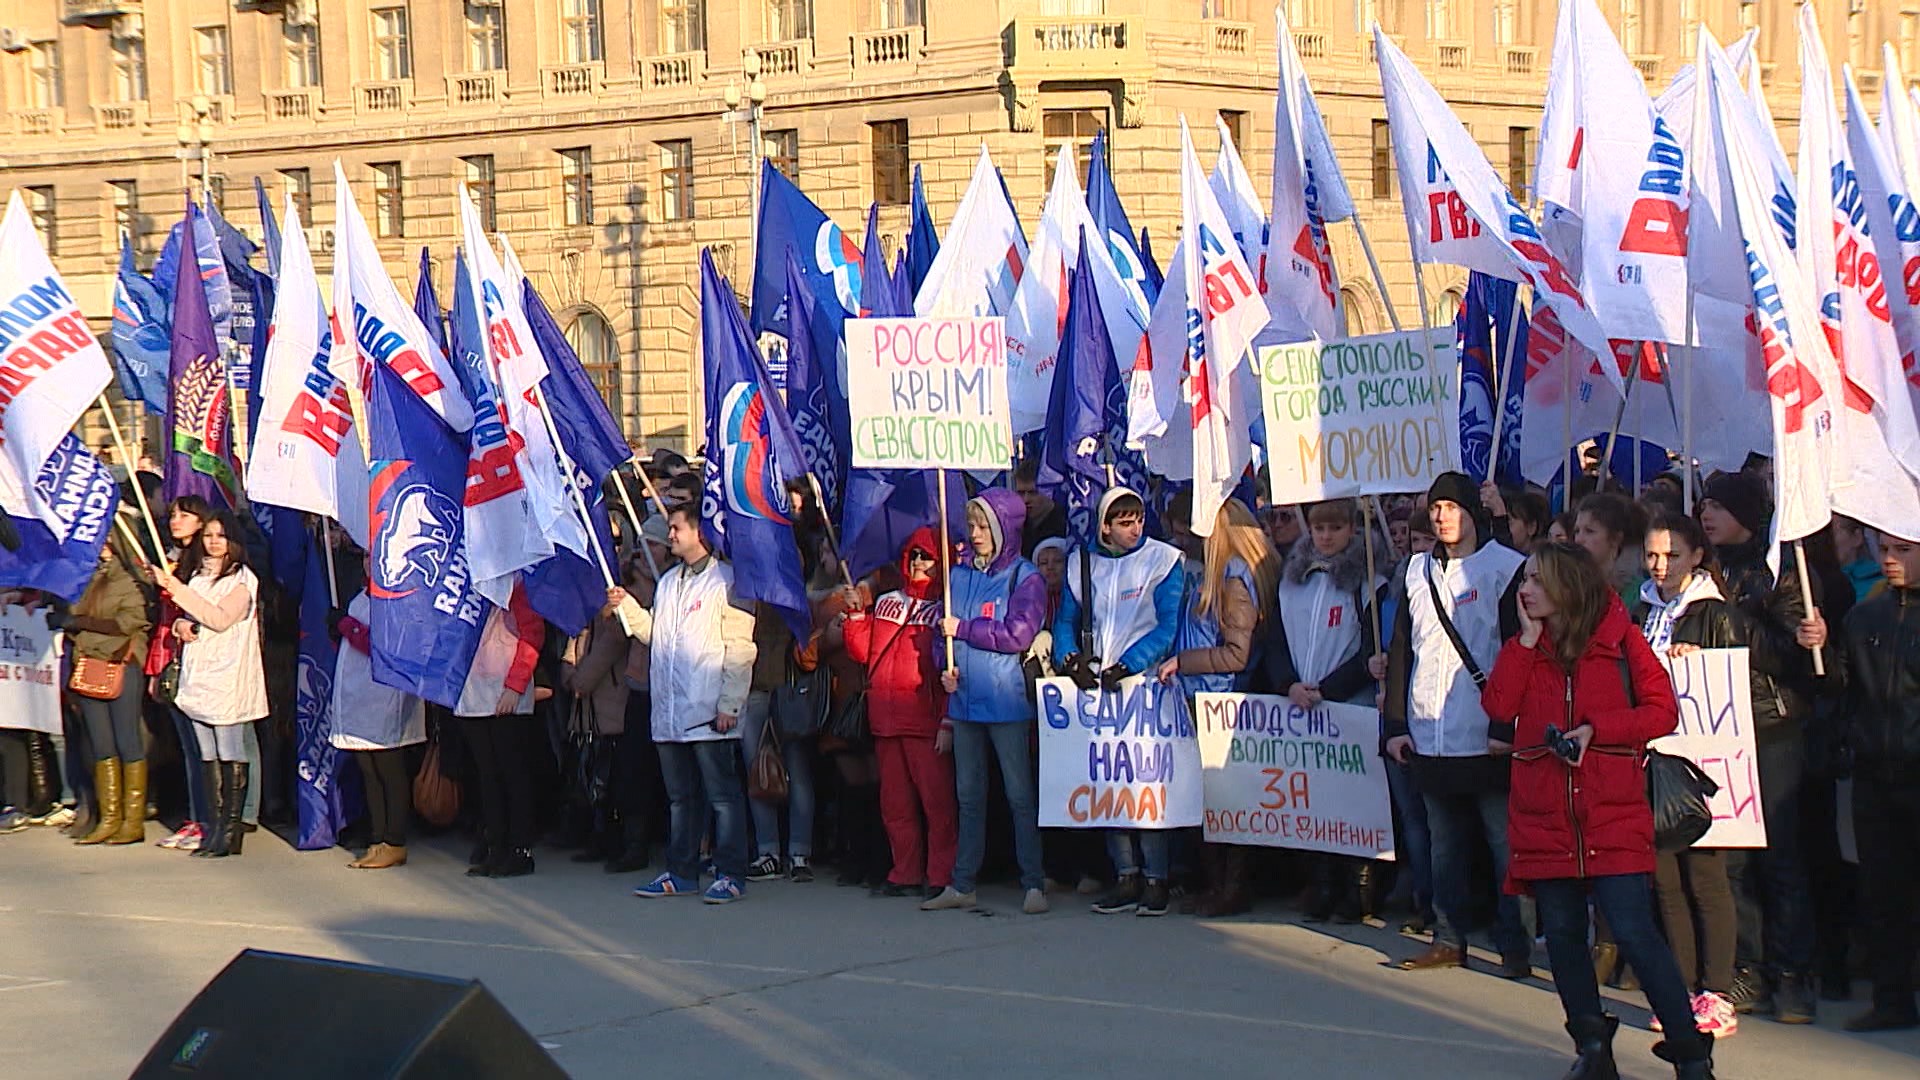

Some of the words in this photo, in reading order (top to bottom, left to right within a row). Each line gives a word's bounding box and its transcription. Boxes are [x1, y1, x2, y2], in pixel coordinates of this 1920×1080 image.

[874, 320, 1004, 368] РОССИЯ!
[1265, 338, 1425, 386] СЕВАСТОПОЛЬ
[891, 367, 993, 416] КРЫМ!
[1273, 384, 1347, 421] ГОРОД
[1357, 373, 1450, 412] РУССКИХ
[1042, 683, 1070, 730] В
[1666, 653, 1740, 737] КИ
[1089, 740, 1175, 784] НАША
[1231, 738, 1367, 776] ВОЛГОГРАДА
[1068, 784, 1168, 823] СИЛА!
[1259, 767, 1310, 810] ЗА
[1695, 749, 1760, 824] ЕЙ
[1206, 810, 1391, 851] ВОССОЕДИНЕНИЕ
